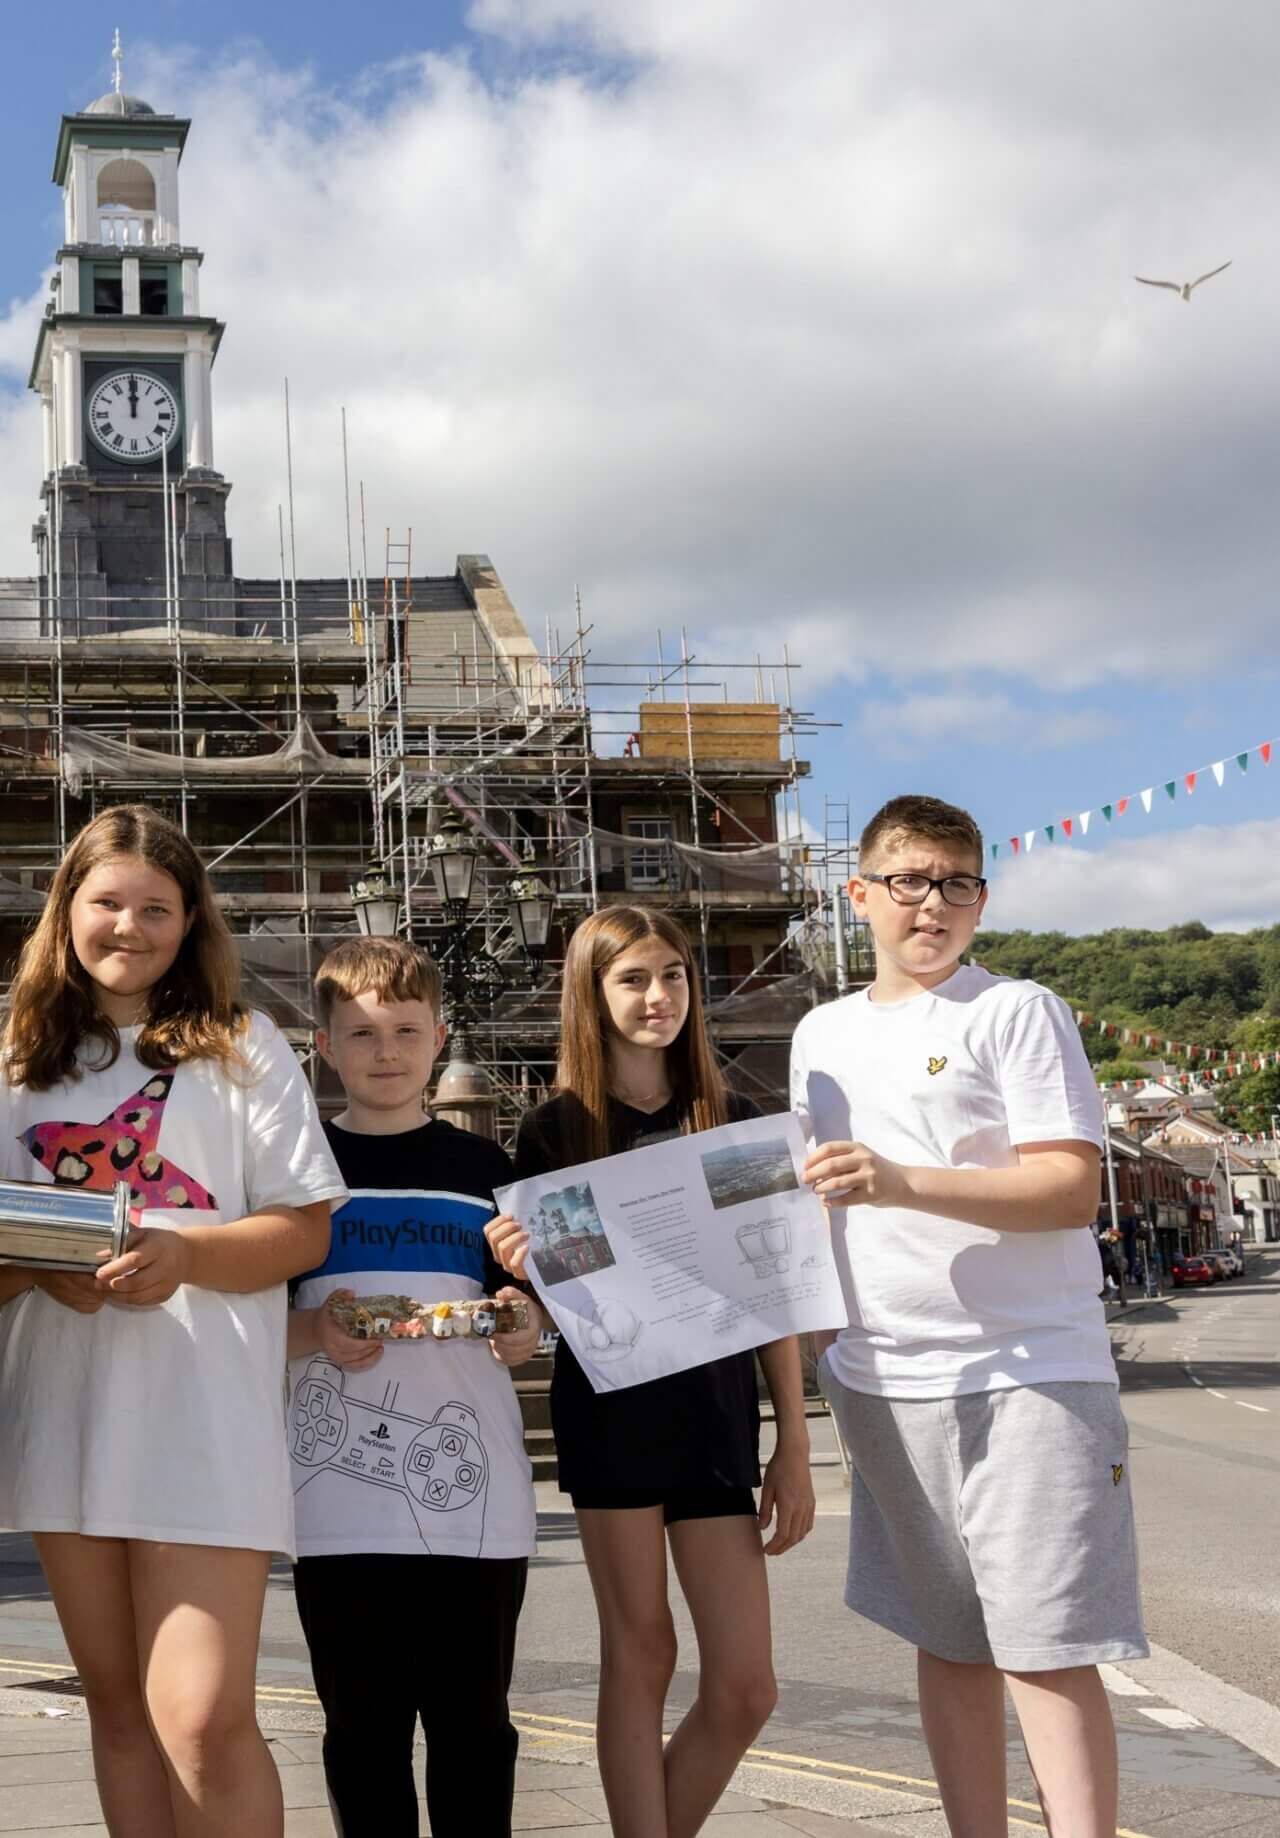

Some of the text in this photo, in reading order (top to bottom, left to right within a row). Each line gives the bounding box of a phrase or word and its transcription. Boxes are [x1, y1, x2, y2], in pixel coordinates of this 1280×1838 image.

[340, 1219, 481, 1253] PlayStation
[341, 1456, 366, 1469] SELECT
[370, 1466, 396, 1479] START
